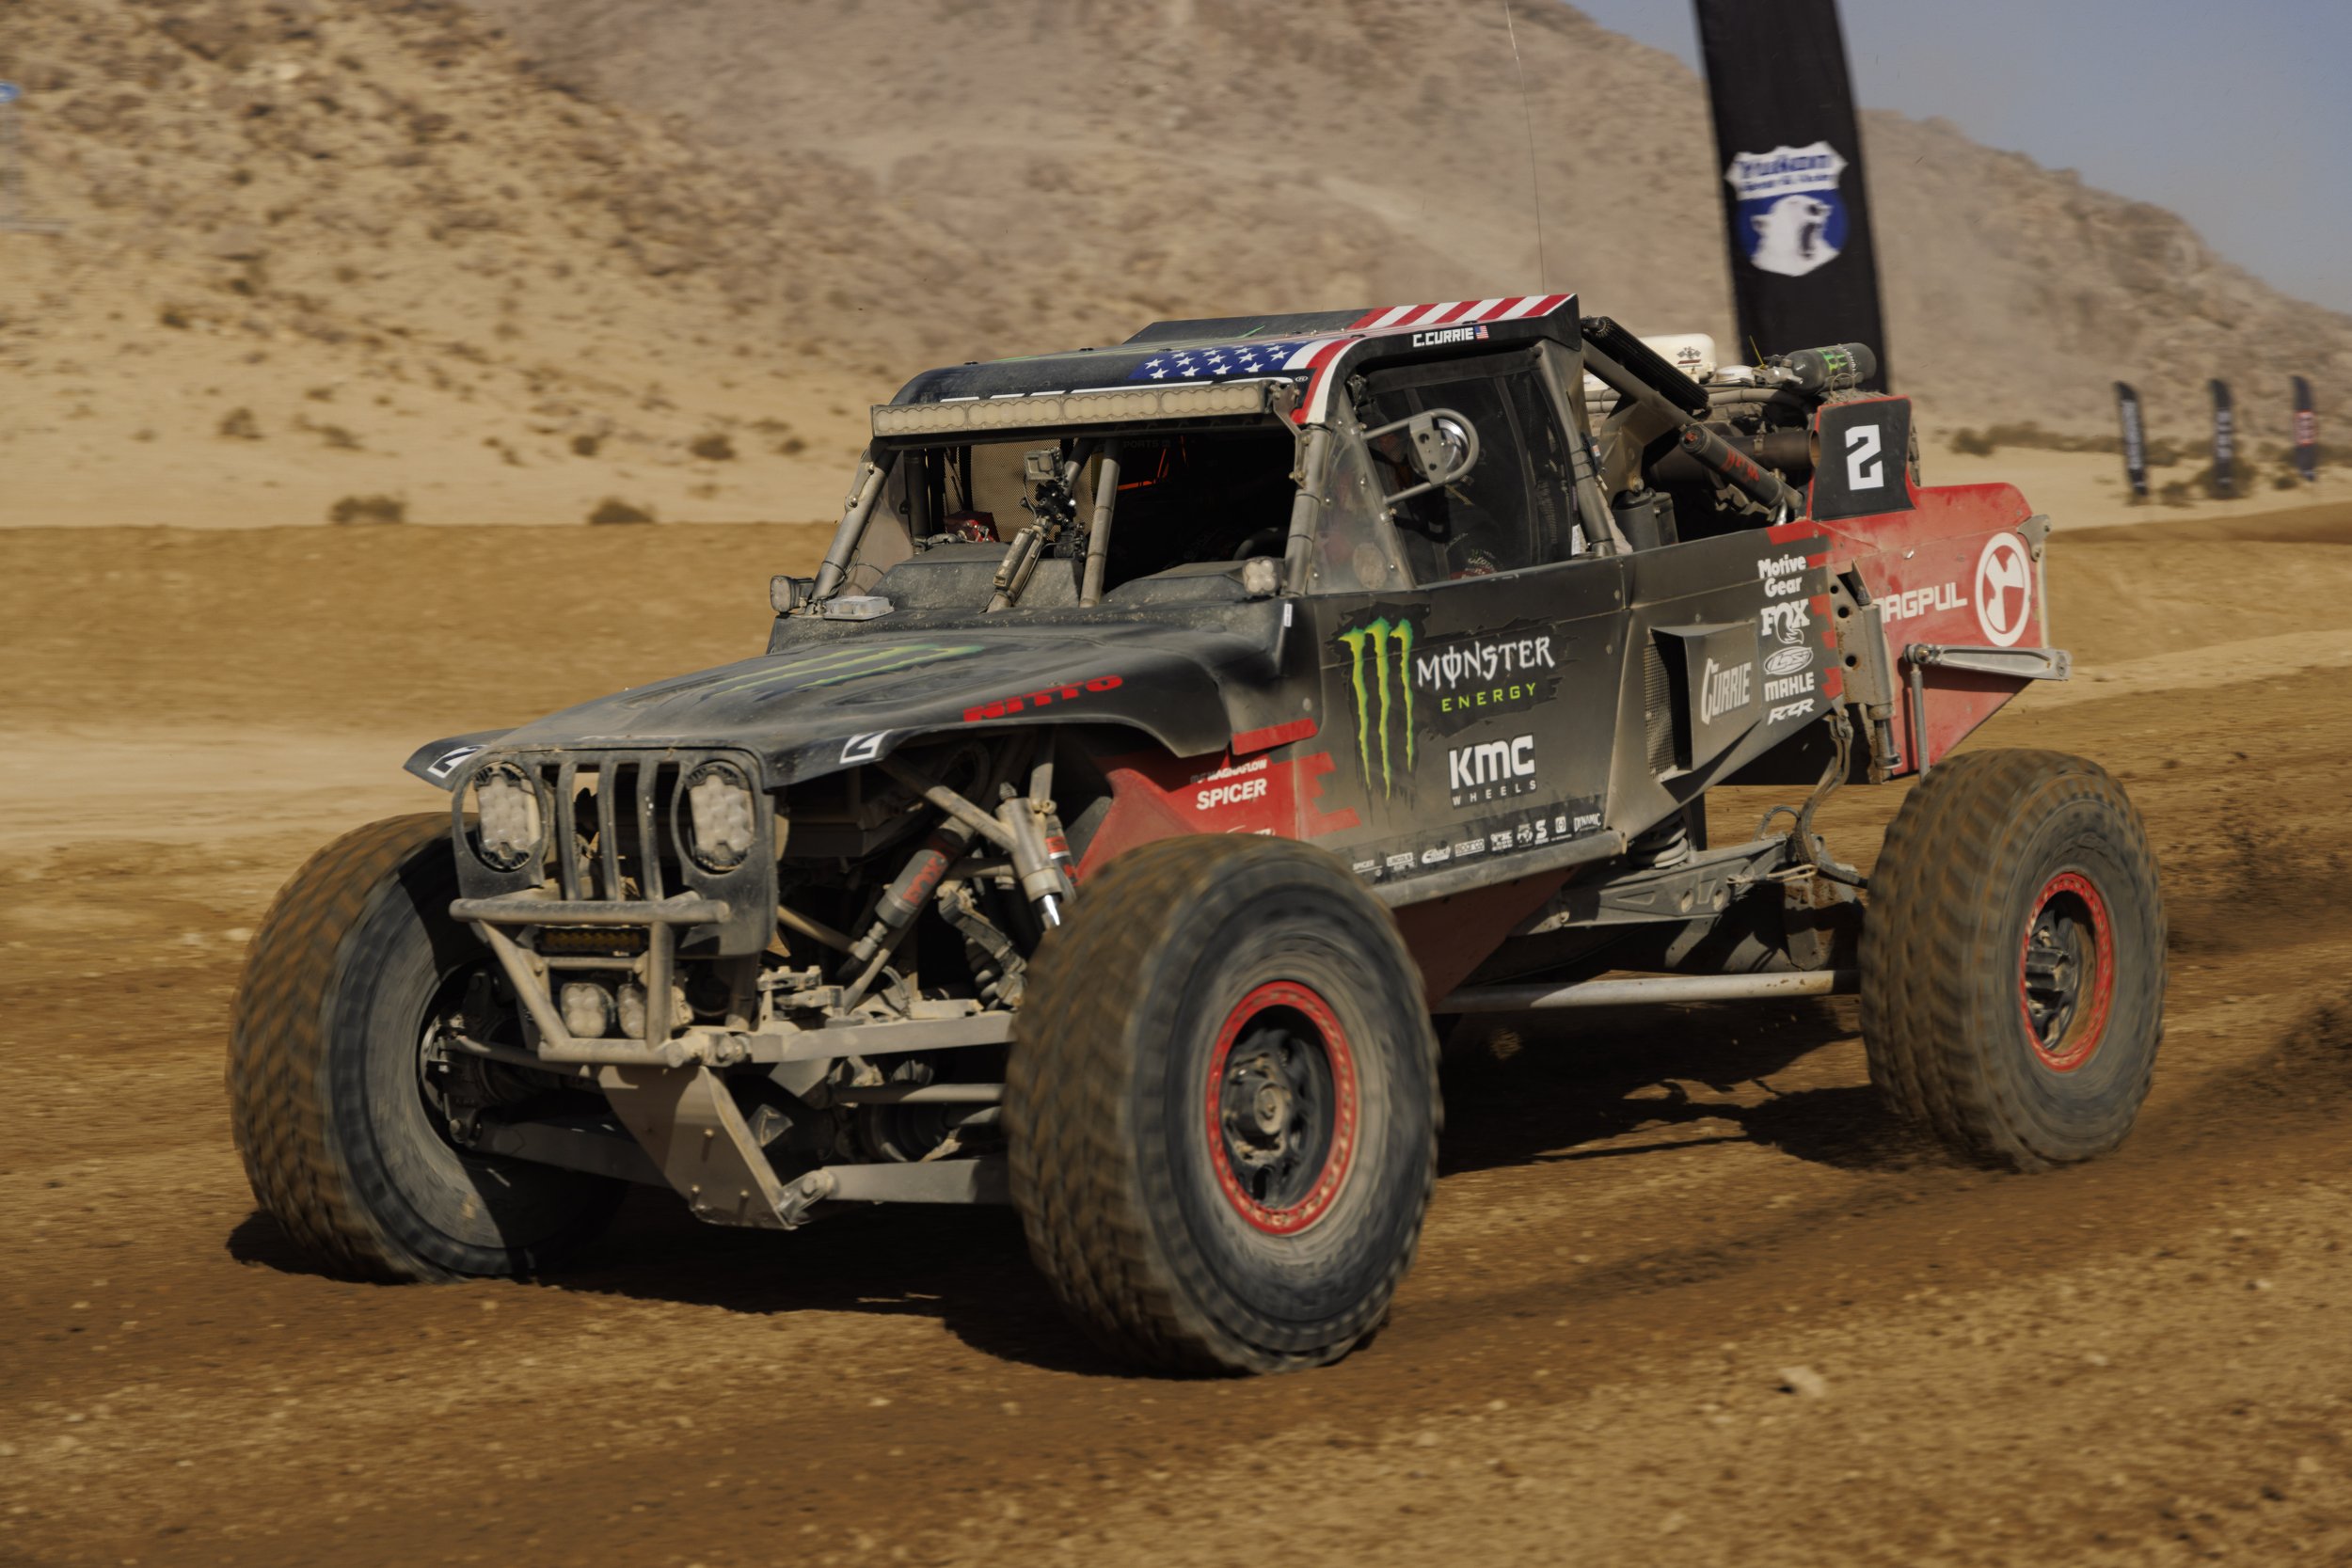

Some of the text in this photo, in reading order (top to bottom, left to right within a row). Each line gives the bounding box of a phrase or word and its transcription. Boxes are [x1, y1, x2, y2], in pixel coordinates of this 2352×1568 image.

[1413, 327, 1474, 348] C.CURRIE
[1845, 424, 1884, 490] 2
[1757, 553, 1807, 579] Motive
[1764, 575, 1803, 598] Gear
[1760, 598, 1810, 645] FOX
[1416, 635, 1555, 690] MONSTER
[963, 674, 1124, 722] NITTO
[1441, 683, 1536, 712] ENERGY
[1701, 657, 1752, 725] CURRIE
[1765, 672, 1815, 702] MAHLE
[1768, 698, 1815, 725] RZR
[1449, 734, 1535, 790] KMC
[1196, 778, 1267, 811] SPICER
[1453, 780, 1537, 806] WHEELS
